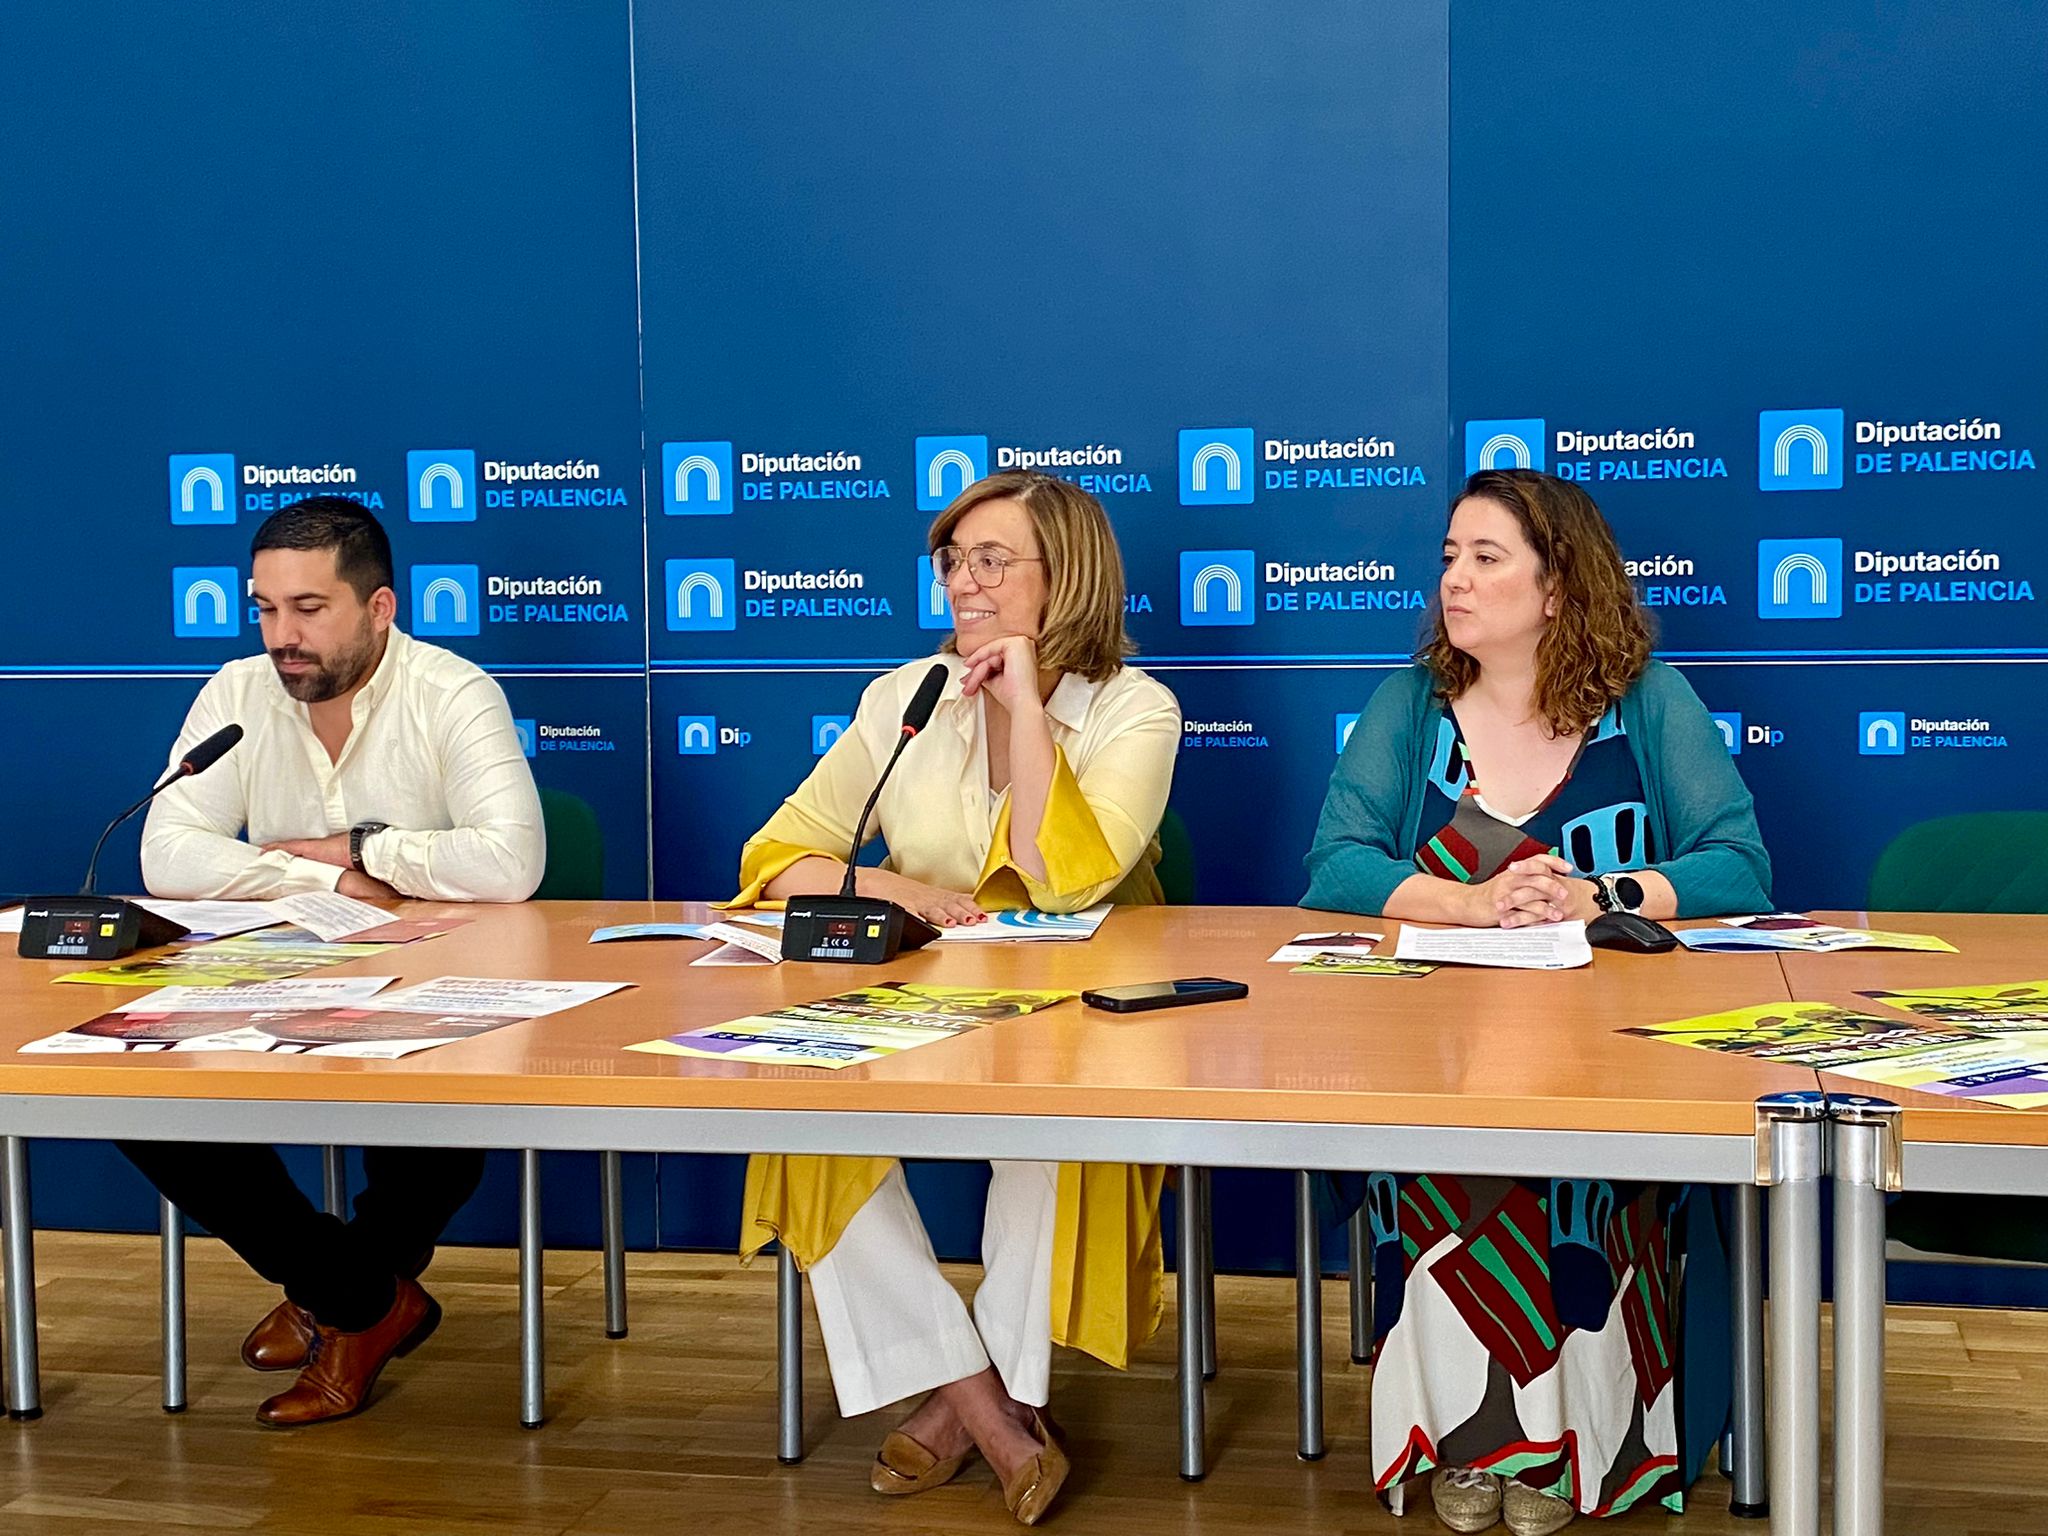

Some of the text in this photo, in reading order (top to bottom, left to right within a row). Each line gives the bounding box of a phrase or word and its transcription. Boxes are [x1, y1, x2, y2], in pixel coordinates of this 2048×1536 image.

[1556, 426, 1695, 455] Diputación
[1856, 417, 2001, 447] Diputación
[997, 444, 1122, 473] Diputación
[1264, 435, 1395, 462] Diputación
[484, 458, 600, 485] Diputación
[741, 449, 861, 477] Diputación
[1557, 458, 1727, 481] DE PALENCIA
[1857, 450, 2035, 473] DE PALENCIA
[243, 462, 357, 488] Diputación
[1066, 474, 1152, 493] ENCIA
[1265, 467, 1426, 489] DE PALENCIA
[486, 488, 627, 508] DE PALENCIA
[743, 480, 888, 500] DE PALENCIA
[246, 493, 273, 510] DE
[1625, 555, 1693, 576] ación
[1854, 547, 2000, 577] Diputación
[744, 567, 864, 594] Diputación
[1265, 559, 1395, 587] Diputación
[487, 574, 602, 600] Diputación
[1640, 586, 1727, 605] ENCIA
[1856, 580, 2034, 603] DE PALENCIA
[746, 597, 892, 617] DE PALENCIA
[1267, 590, 1426, 611] DE PALENCIA
[489, 603, 628, 623] DE PALENCIA
[539, 723, 601, 740] Diputación
[1184, 719, 1253, 735] Diputación
[1910, 716, 1990, 734] Diputación
[540, 740, 614, 751] DE PALENCIA
[721, 728, 751, 747] Dip
[1185, 736, 1268, 748] DE PALENCIA
[1748, 726, 1783, 748] Dip
[1911, 735, 2007, 748] DE PALENCIA
